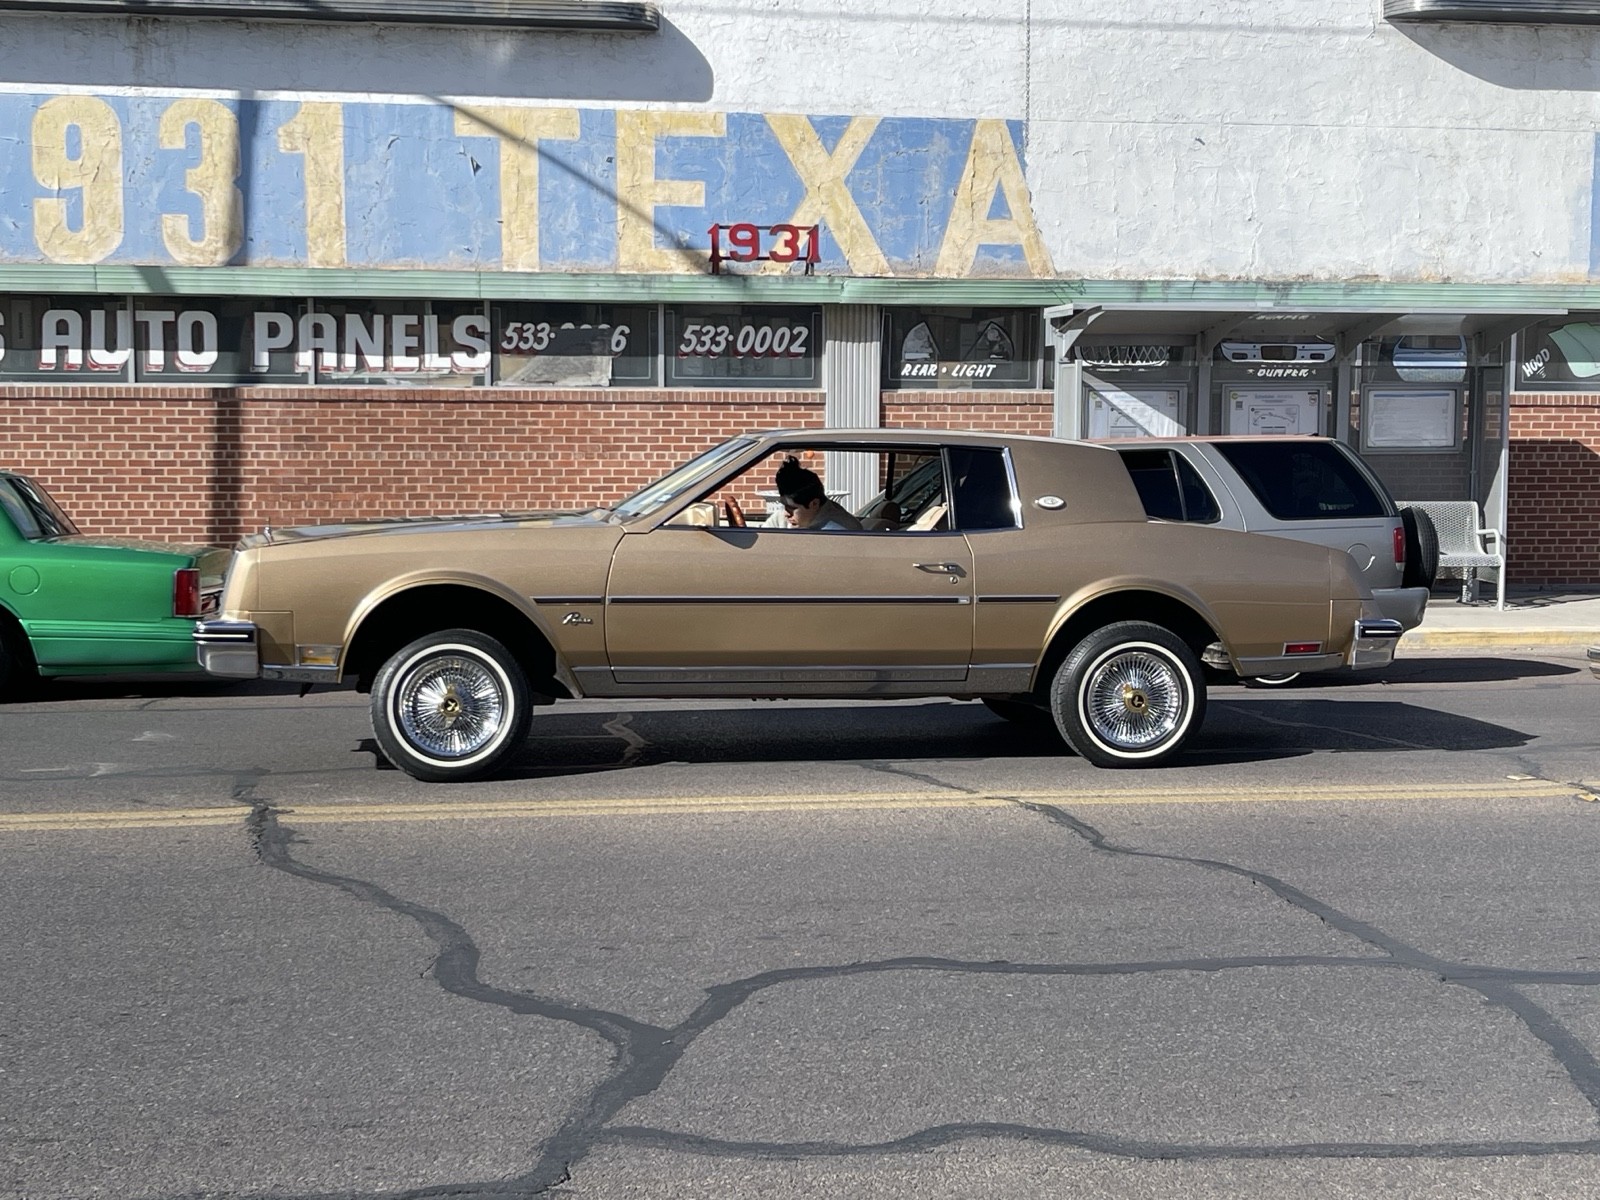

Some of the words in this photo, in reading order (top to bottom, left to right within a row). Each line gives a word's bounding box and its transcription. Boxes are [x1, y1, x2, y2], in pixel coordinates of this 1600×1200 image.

[31, 94, 347, 269] 931
[454, 105, 1056, 279] TEXA
[707, 223, 821, 263] 1931
[38, 310, 218, 372] AUTO
[250, 311, 491, 374] PANELS
[901, 364, 938, 377] REAR
[951, 364, 996, 377] LIGHT
[1522, 348, 1550, 377] HOOD
